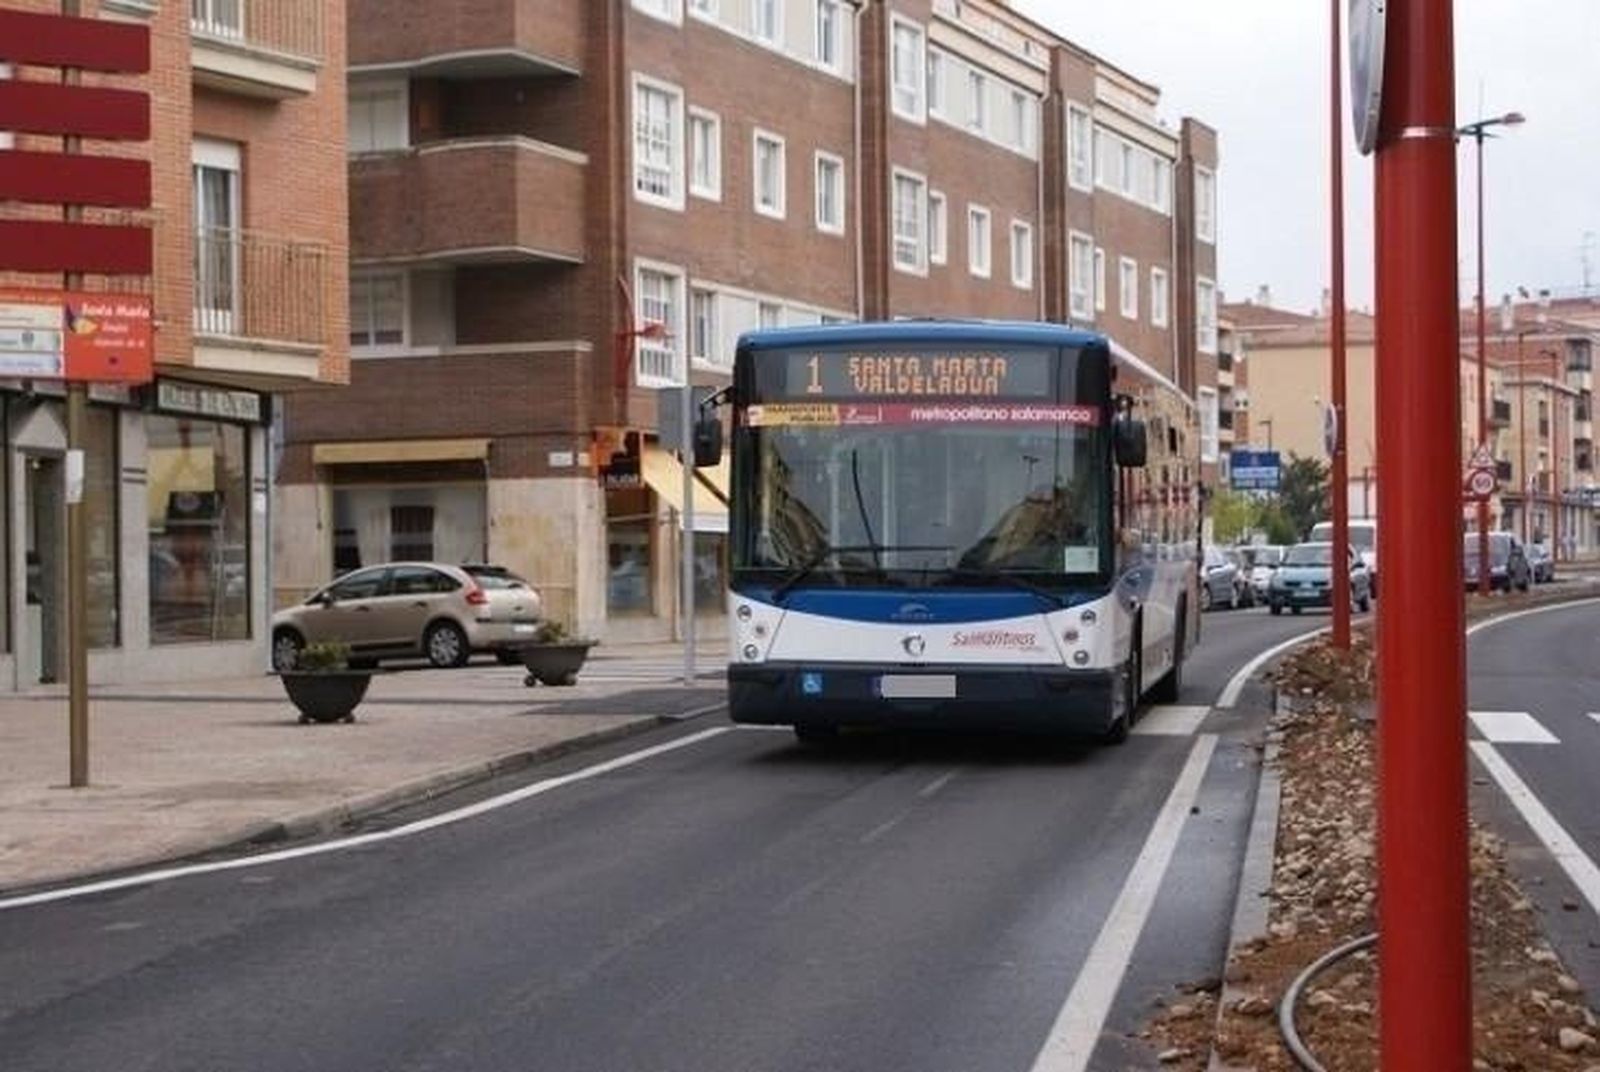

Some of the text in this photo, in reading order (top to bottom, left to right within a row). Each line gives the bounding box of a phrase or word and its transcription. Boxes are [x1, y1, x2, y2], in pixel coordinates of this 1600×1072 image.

[805, 356, 823, 394] 1
[848, 356, 1008, 378] SANTA MARTA
[853, 376, 999, 395] VALDELAGUA
[910, 406, 1009, 421] metropolitano
